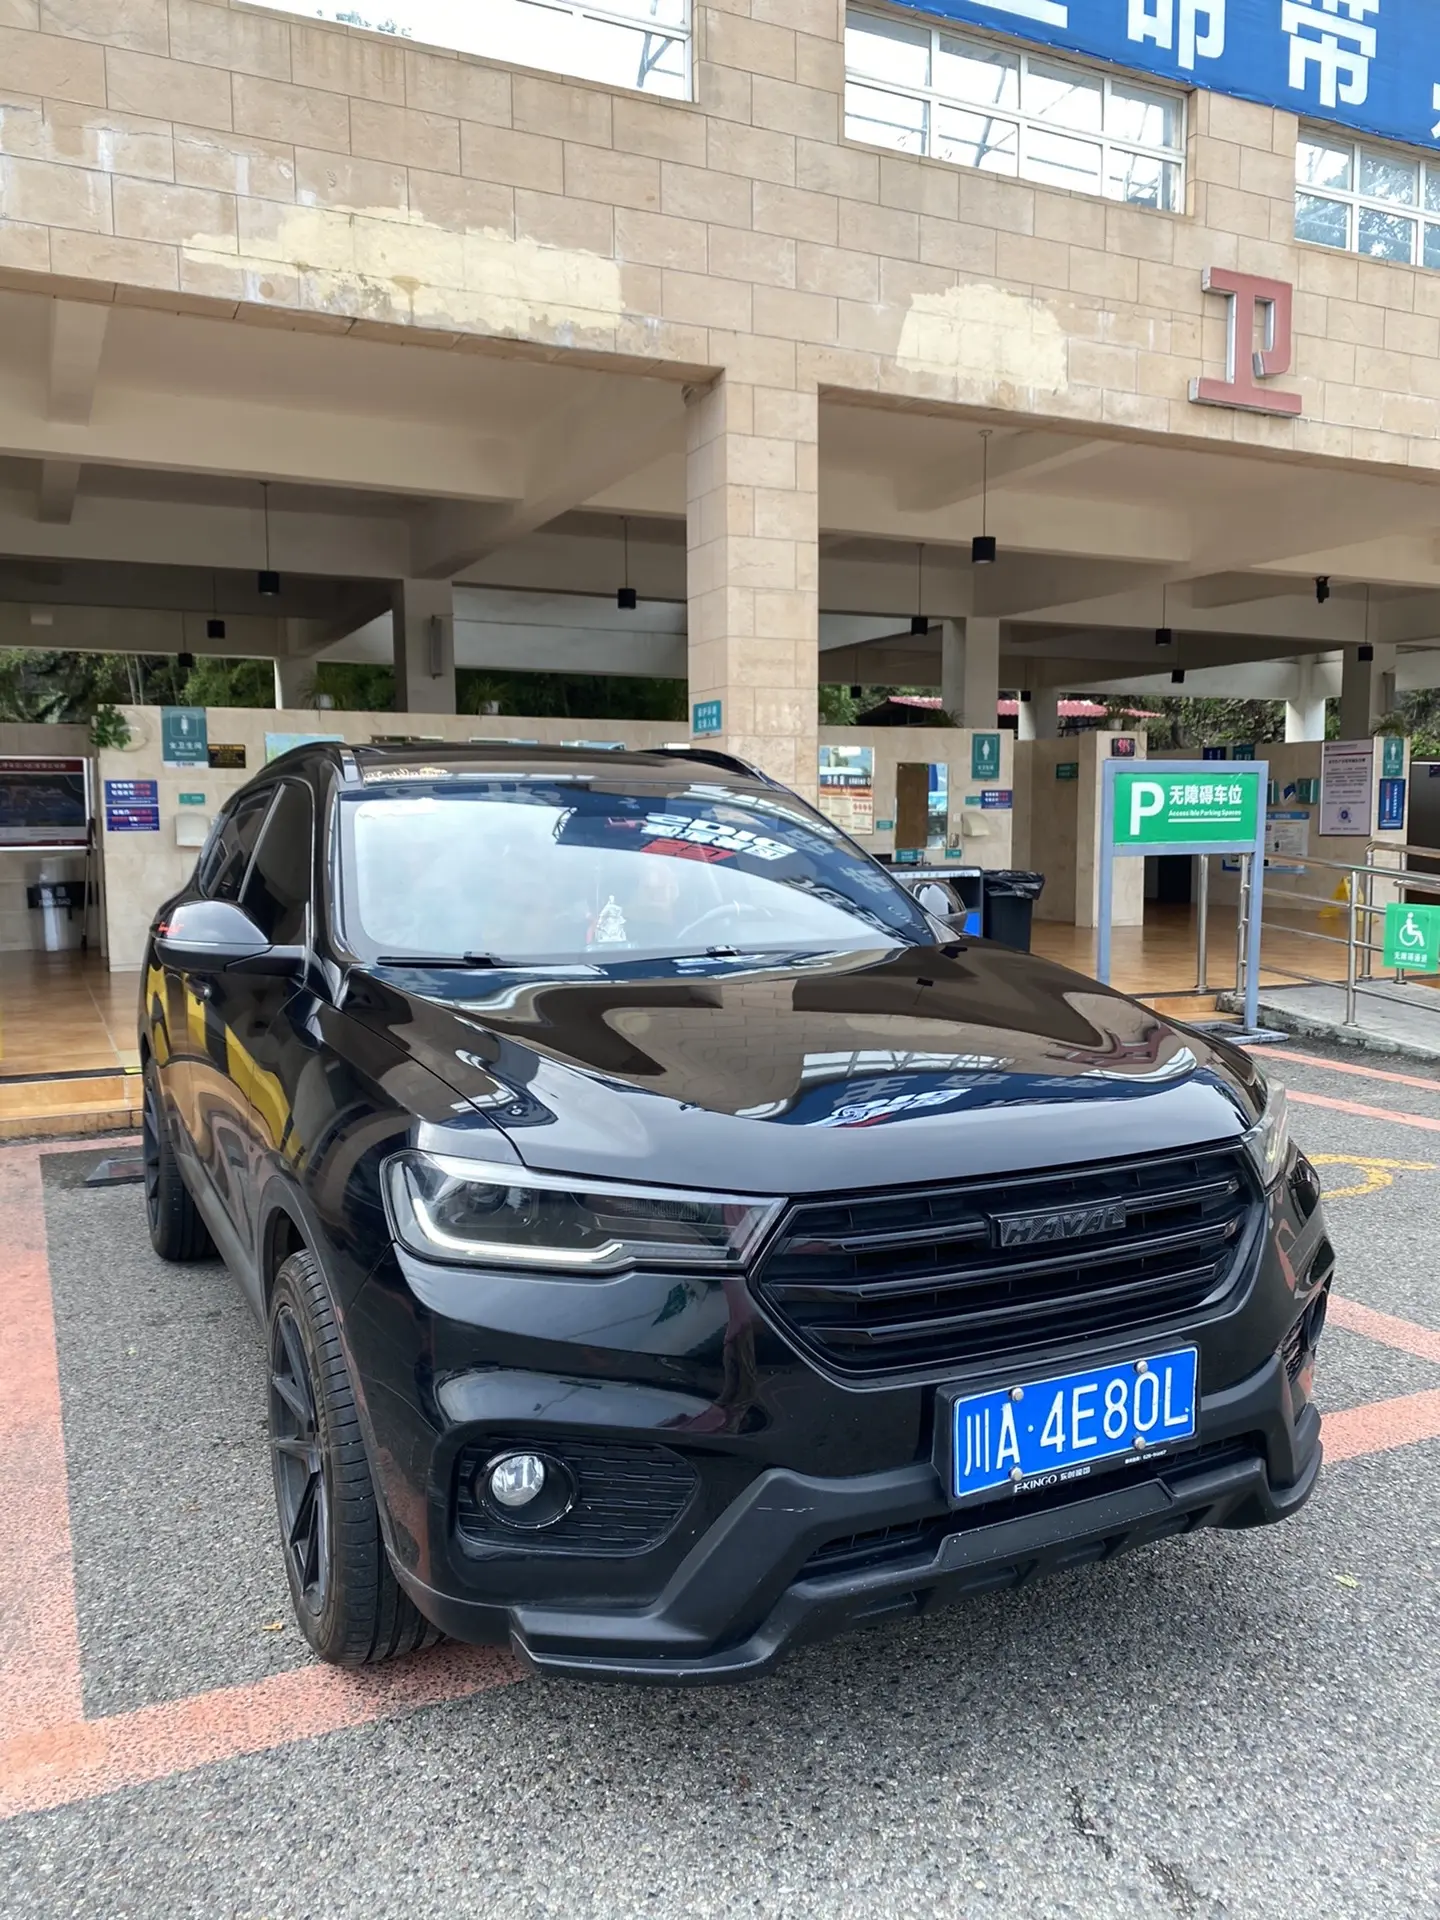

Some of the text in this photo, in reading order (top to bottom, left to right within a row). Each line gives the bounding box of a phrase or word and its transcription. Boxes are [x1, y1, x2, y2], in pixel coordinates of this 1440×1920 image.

[1187, 266, 1301, 416] 卫
[1130, 782, 1165, 836] P
[1169, 785, 1243, 806] 无障碍车位
[1200, 809, 1221, 819] Parking
[1221, 809, 1242, 818] Spaces
[1005, 1206, 1124, 1244] HAVAL
